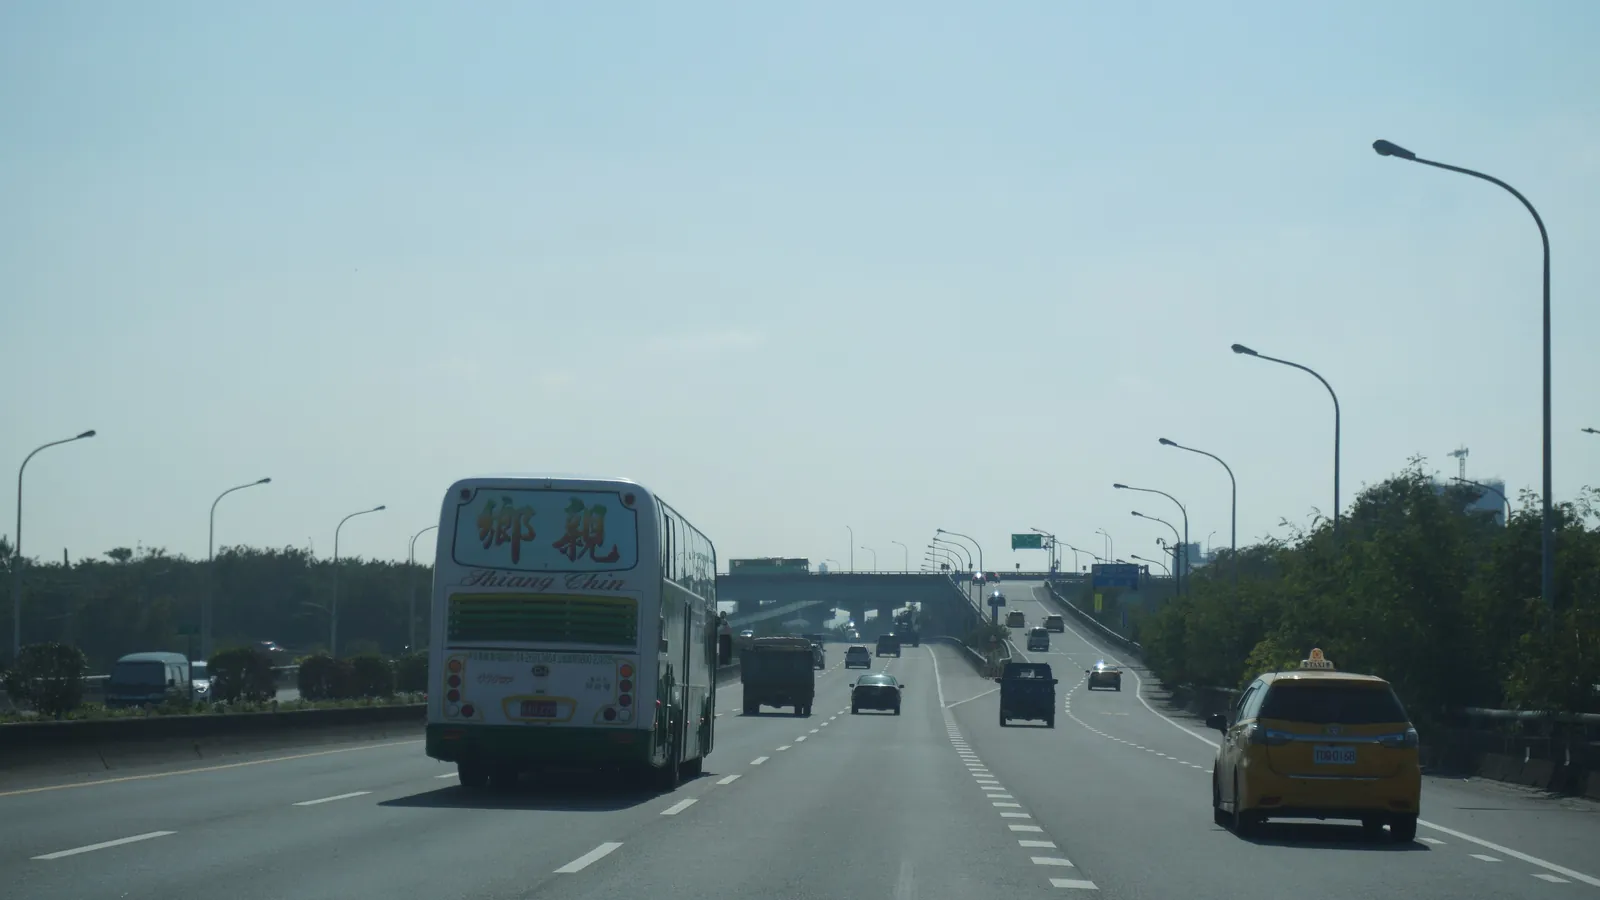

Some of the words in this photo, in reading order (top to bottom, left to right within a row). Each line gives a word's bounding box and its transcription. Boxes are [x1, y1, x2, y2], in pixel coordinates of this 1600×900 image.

[477, 495, 620, 564] 鄉親
[461, 569, 555, 592] Shiang
[564, 572, 626, 591] Chin
